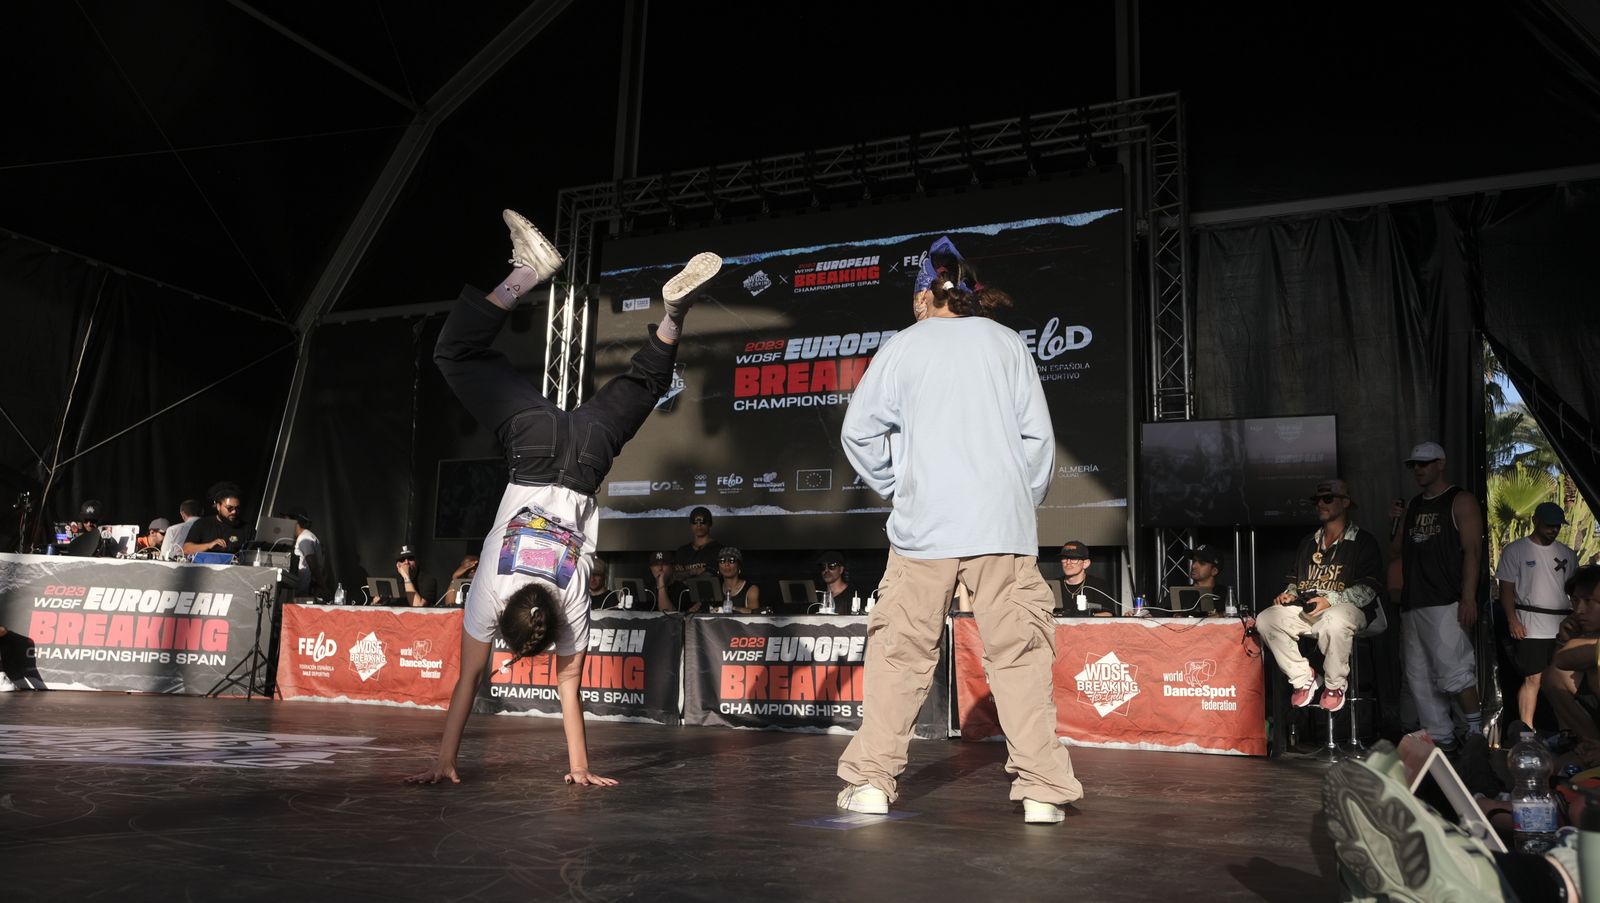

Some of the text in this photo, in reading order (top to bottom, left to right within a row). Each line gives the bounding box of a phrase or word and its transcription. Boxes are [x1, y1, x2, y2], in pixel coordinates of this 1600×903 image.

[815, 256, 880, 271] EUROPEAN
[794, 266, 880, 288] BREAKING
[793, 283, 855, 293] CHAMPIONSHIPS
[736, 330, 899, 364] WDSF EUROP
[745, 339, 785, 352] 2023
[734, 357, 872, 397] BREAK
[733, 393, 852, 411] CHAMPIONSH
[44, 585, 86, 596] 2023
[1299, 580, 1345, 592] BREAKING
[33, 587, 233, 616] WDSF EUROPEAN
[28, 611, 230, 652] BREAKING
[356, 640, 382, 654] WDSF
[722, 636, 866, 661] WDSF EUROPE
[730, 637, 765, 647] 2023
[26, 647, 226, 666] CHAMPIONSHIPS SPAIN
[400, 658, 442, 670] DanceSport
[490, 651, 645, 690] BREING
[1085, 663, 1130, 681] WDSF
[1163, 671, 1184, 682] world
[720, 664, 864, 702] BREAKI
[1077, 680, 1138, 693] BREAKING
[490, 686, 644, 704] CHAMPIONPS SPAIN
[1163, 684, 1237, 700] DanceSport
[719, 702, 852, 717] CHAMPIONSHIPS
[1201, 699, 1237, 711] federation
